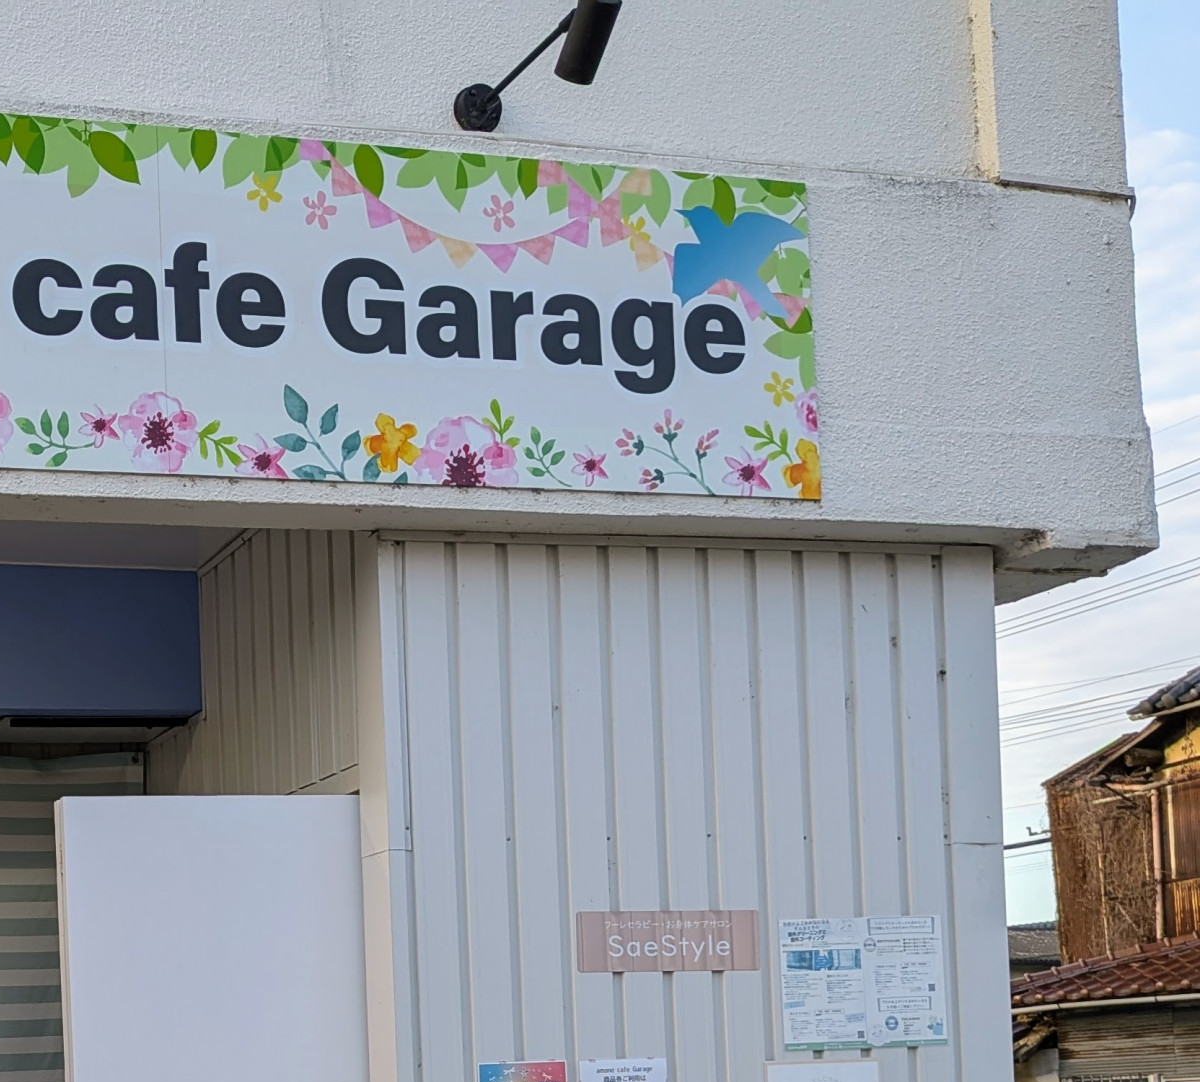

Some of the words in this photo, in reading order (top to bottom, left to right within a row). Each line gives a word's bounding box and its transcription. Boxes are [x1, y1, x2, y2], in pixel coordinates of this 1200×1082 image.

[13, 241, 285, 347] cafe
[322, 258, 745, 393] Garage
[608, 934, 731, 962] SaeStyle
[604, 1075, 646, 1082] 商品券ご利用は
